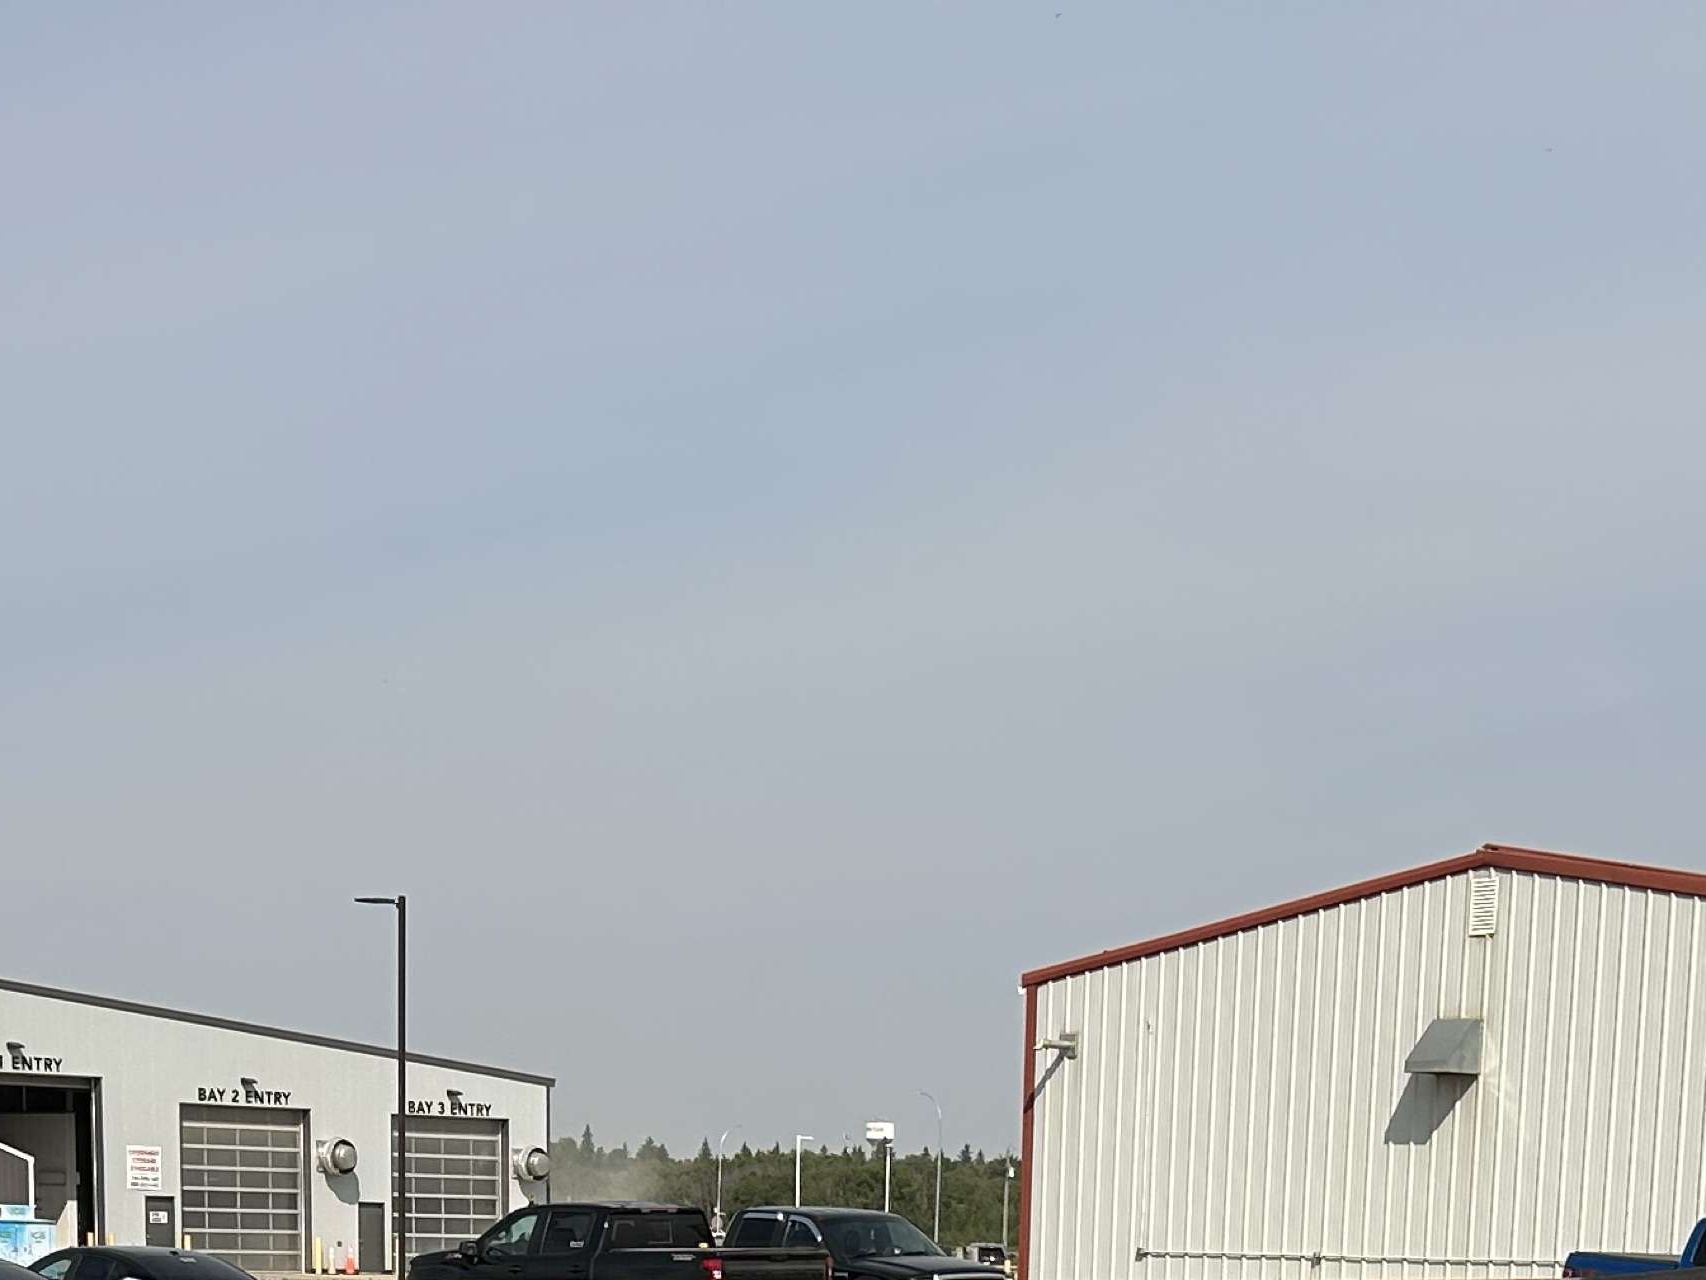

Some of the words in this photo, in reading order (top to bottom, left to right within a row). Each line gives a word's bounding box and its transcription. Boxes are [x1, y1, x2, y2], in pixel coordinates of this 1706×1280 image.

[11, 1055, 63, 1073] ENTRY
[198, 1087, 225, 1103] BAY
[231, 1089, 240, 1104] 2
[245, 1090, 291, 1106] ENTRY
[408, 1101, 434, 1115] BAY
[438, 1102, 445, 1116] 3
[449, 1103, 493, 1117] ENTRY
